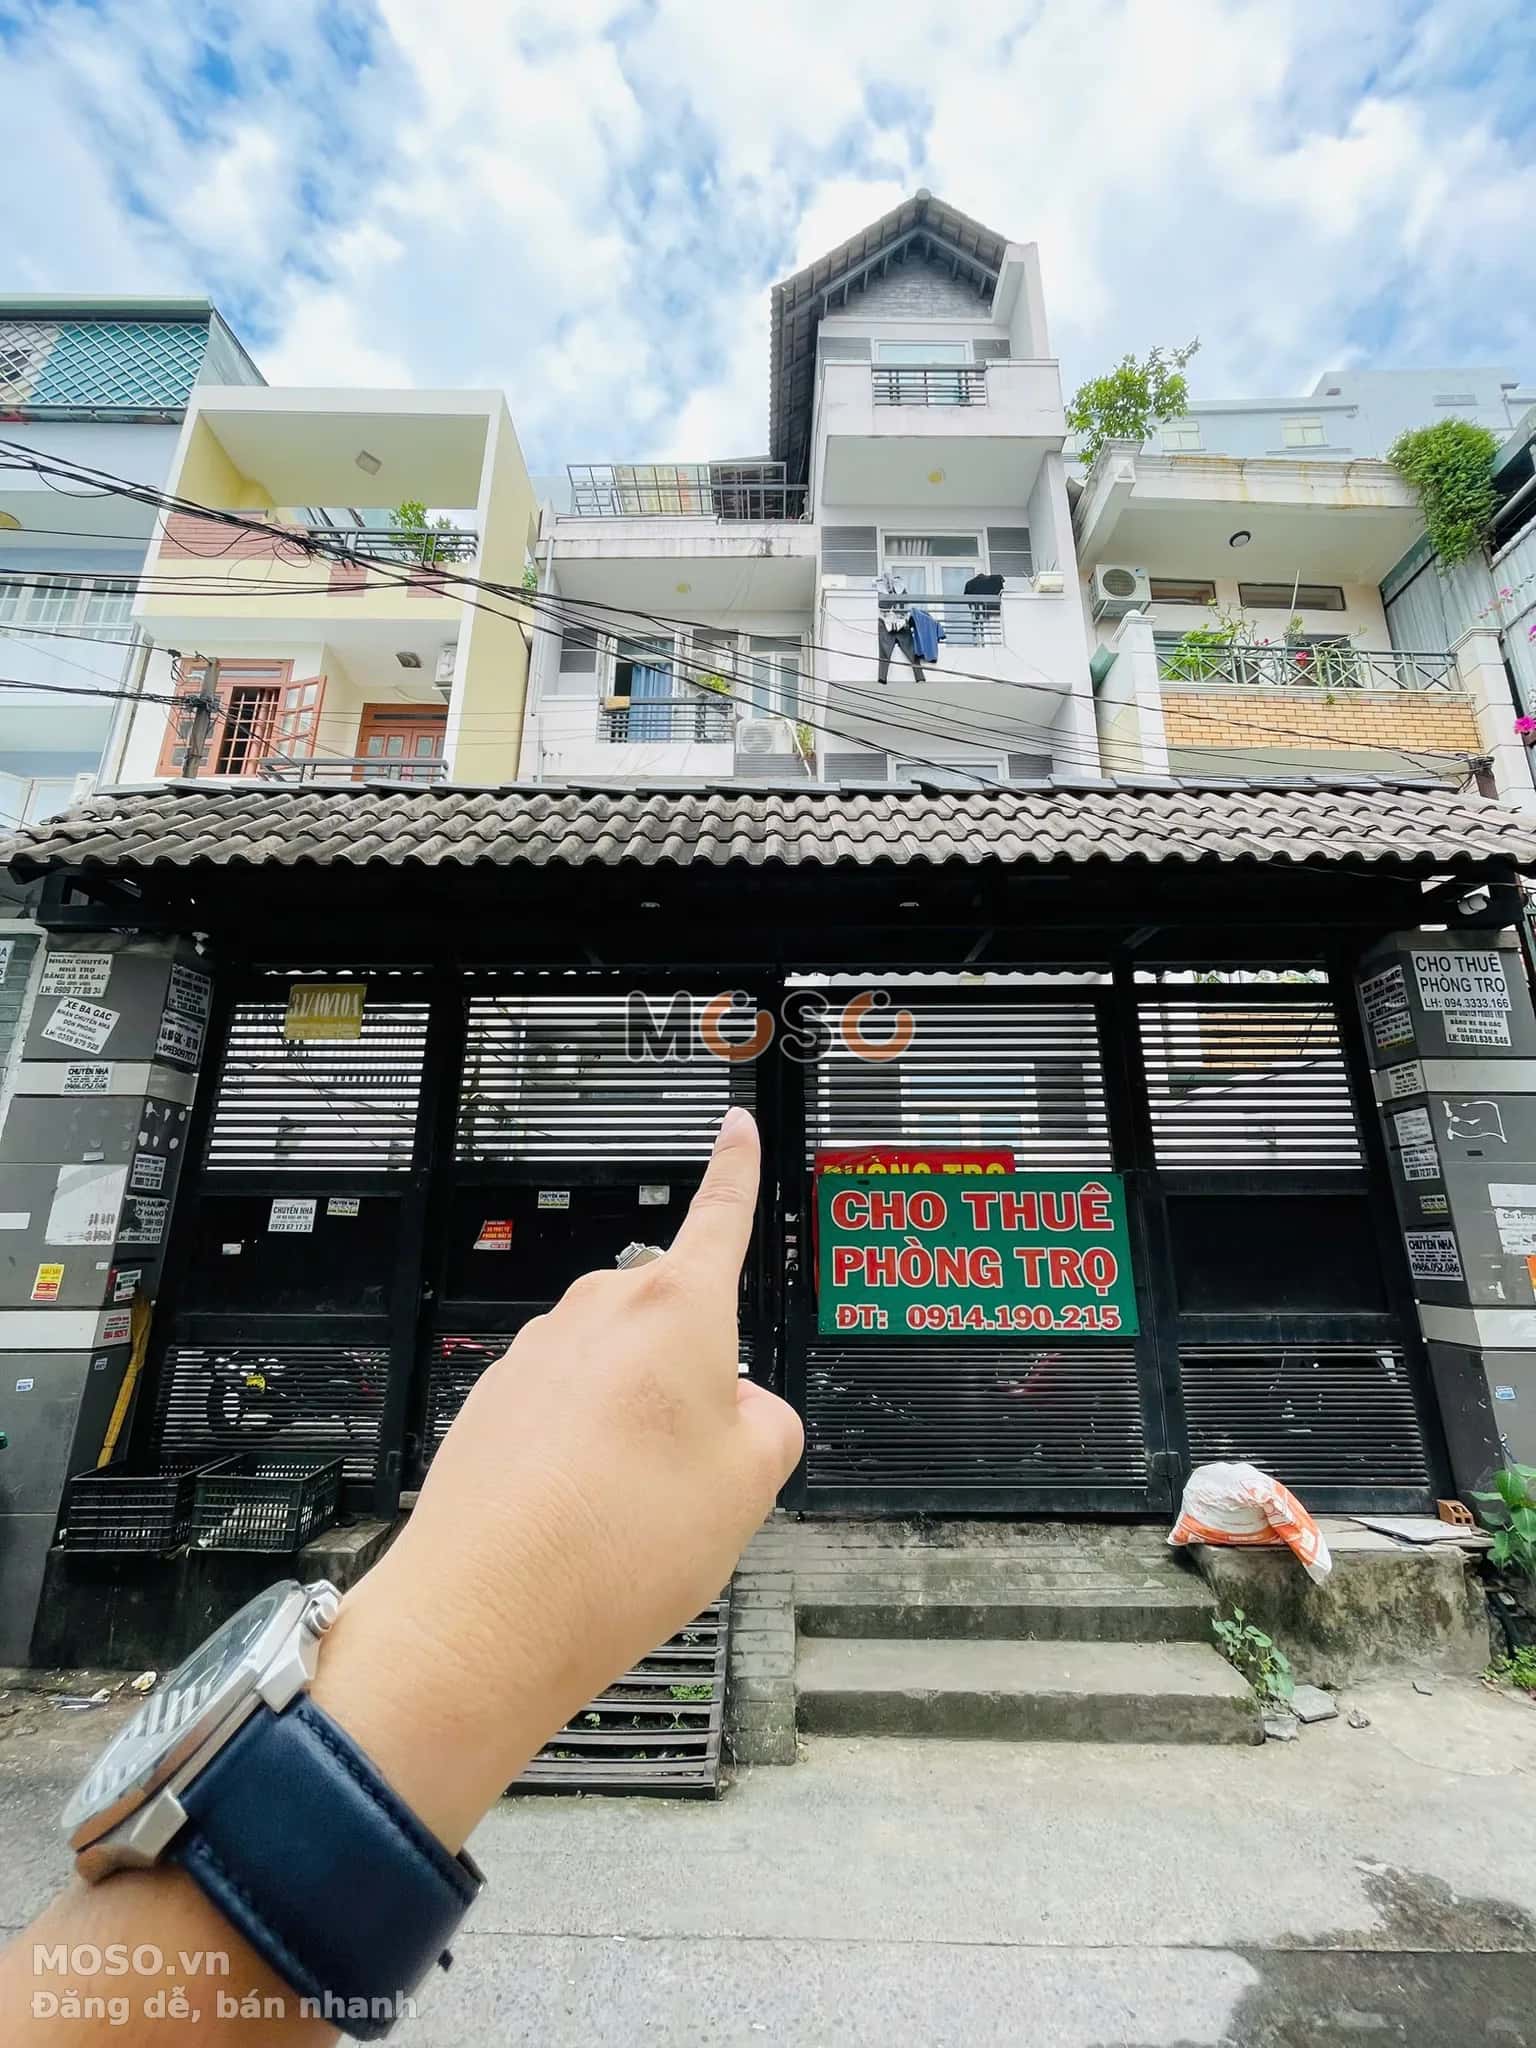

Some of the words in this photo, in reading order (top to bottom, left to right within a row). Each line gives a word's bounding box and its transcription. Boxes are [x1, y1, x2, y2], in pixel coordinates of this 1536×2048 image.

[1415, 956, 1451, 973] CHO
[1454, 953, 1502, 973] THUÊ
[1420, 974, 1472, 993] PHÒNG
[1474, 977, 1506, 997] TRỌ
[65, 999, 79, 1010] XE
[79, 1004, 91, 1015] BA
[1424, 998, 1443, 1009] LH:
[1444, 998, 1509, 1009] 094.3333.166
[831, 1190, 947, 1231] CHO
[961, 1182, 1114, 1232] THUÊ
[832, 1236, 1003, 1289] PHÒNG
[1014, 1247, 1119, 1297] TRỌ
[836, 1303, 889, 1329] ĐT:
[906, 1303, 1122, 1330] 0914.190.215
